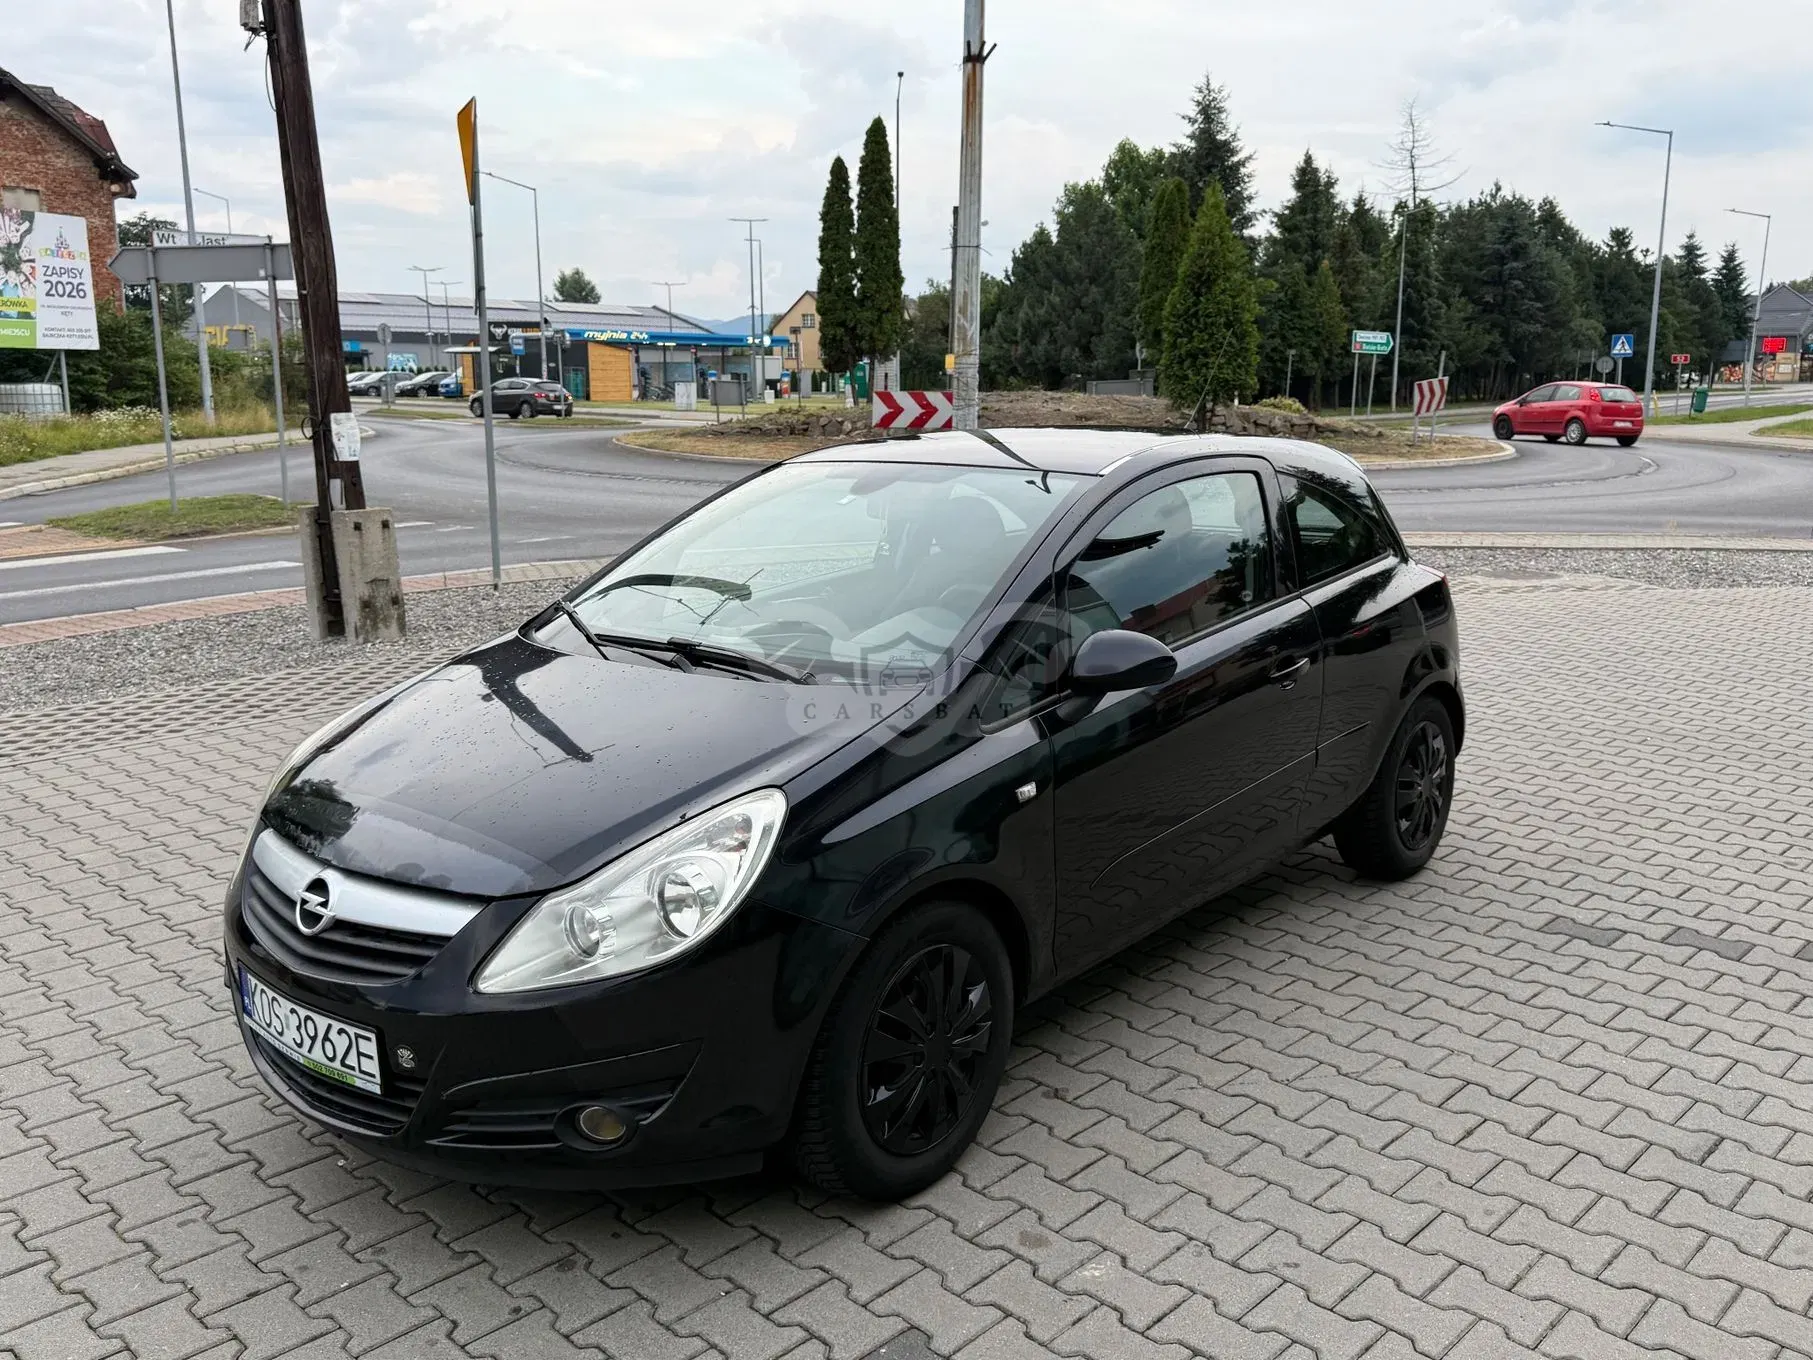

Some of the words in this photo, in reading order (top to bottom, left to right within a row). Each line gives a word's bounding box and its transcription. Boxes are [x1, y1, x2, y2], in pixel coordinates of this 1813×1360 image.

[41, 265, 84, 279] ZAPISY
[43, 280, 87, 299] 2026
[584, 330, 628, 341] myjnia
[630, 331, 649, 340] 24h
[248, 977, 285, 1038] KOS
[289, 1007, 376, 1079] 3962E
